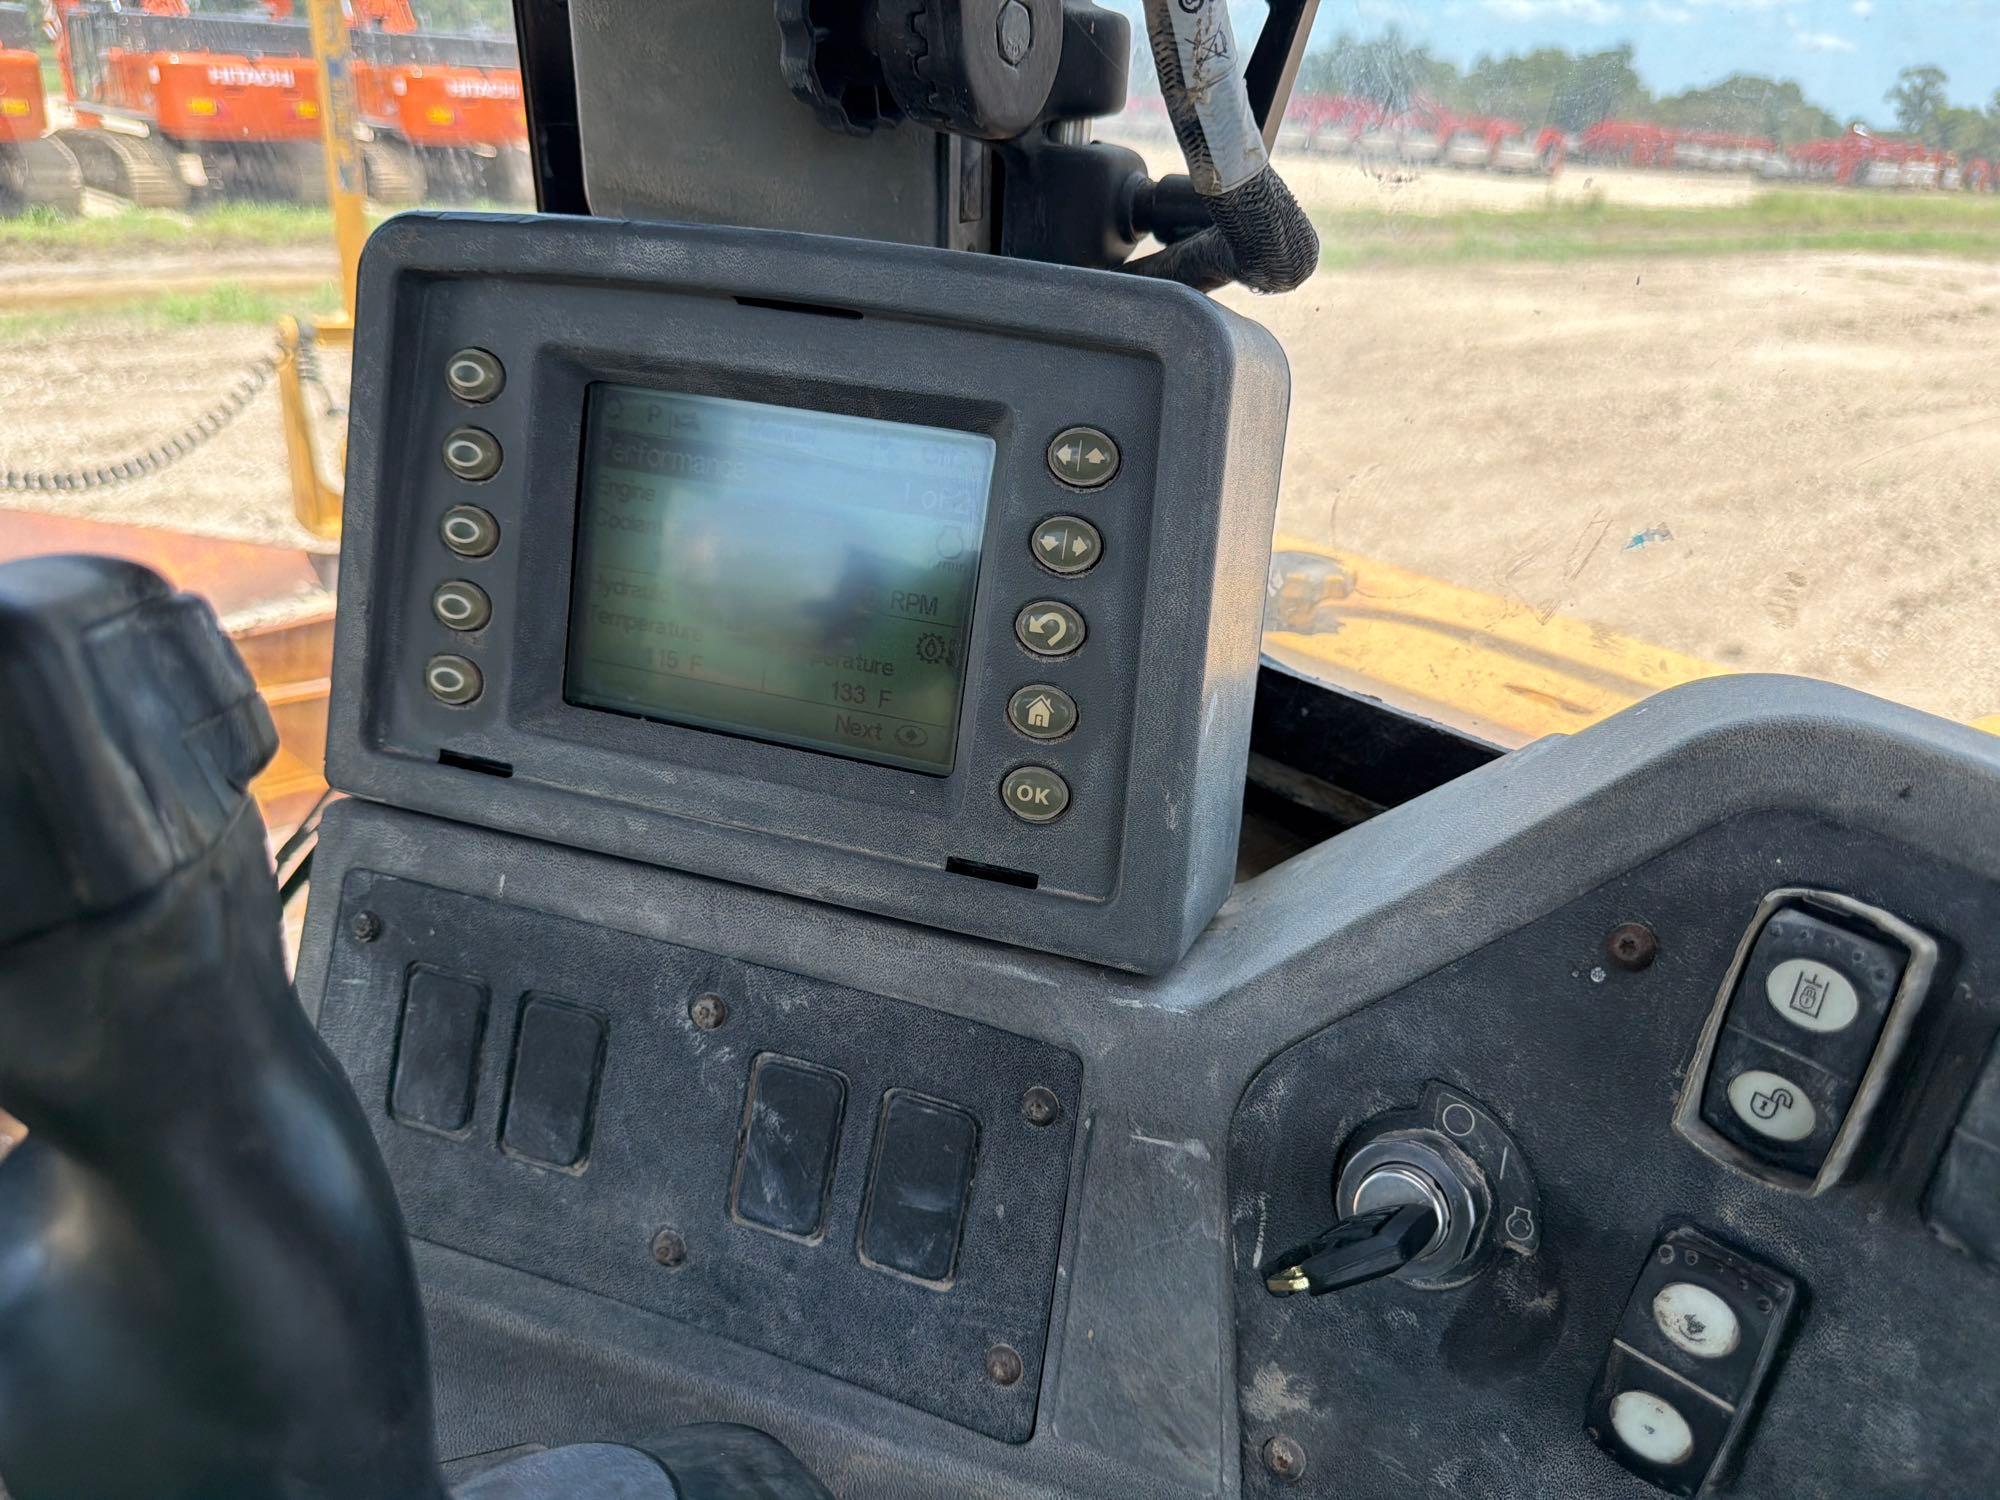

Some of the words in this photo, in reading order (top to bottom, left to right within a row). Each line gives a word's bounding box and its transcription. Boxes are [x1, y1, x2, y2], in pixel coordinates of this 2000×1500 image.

[207, 66, 295, 88] HITACHI
[600, 436, 746, 480] Performance
[598, 474, 657, 504] Engine
[890, 589, 939, 617] RPM
[590, 603, 705, 643] Temperature
[831, 680, 866, 704] 133
[878, 689, 893, 709] F
[834, 713, 883, 741] Next
[1016, 783, 1050, 806] OK
